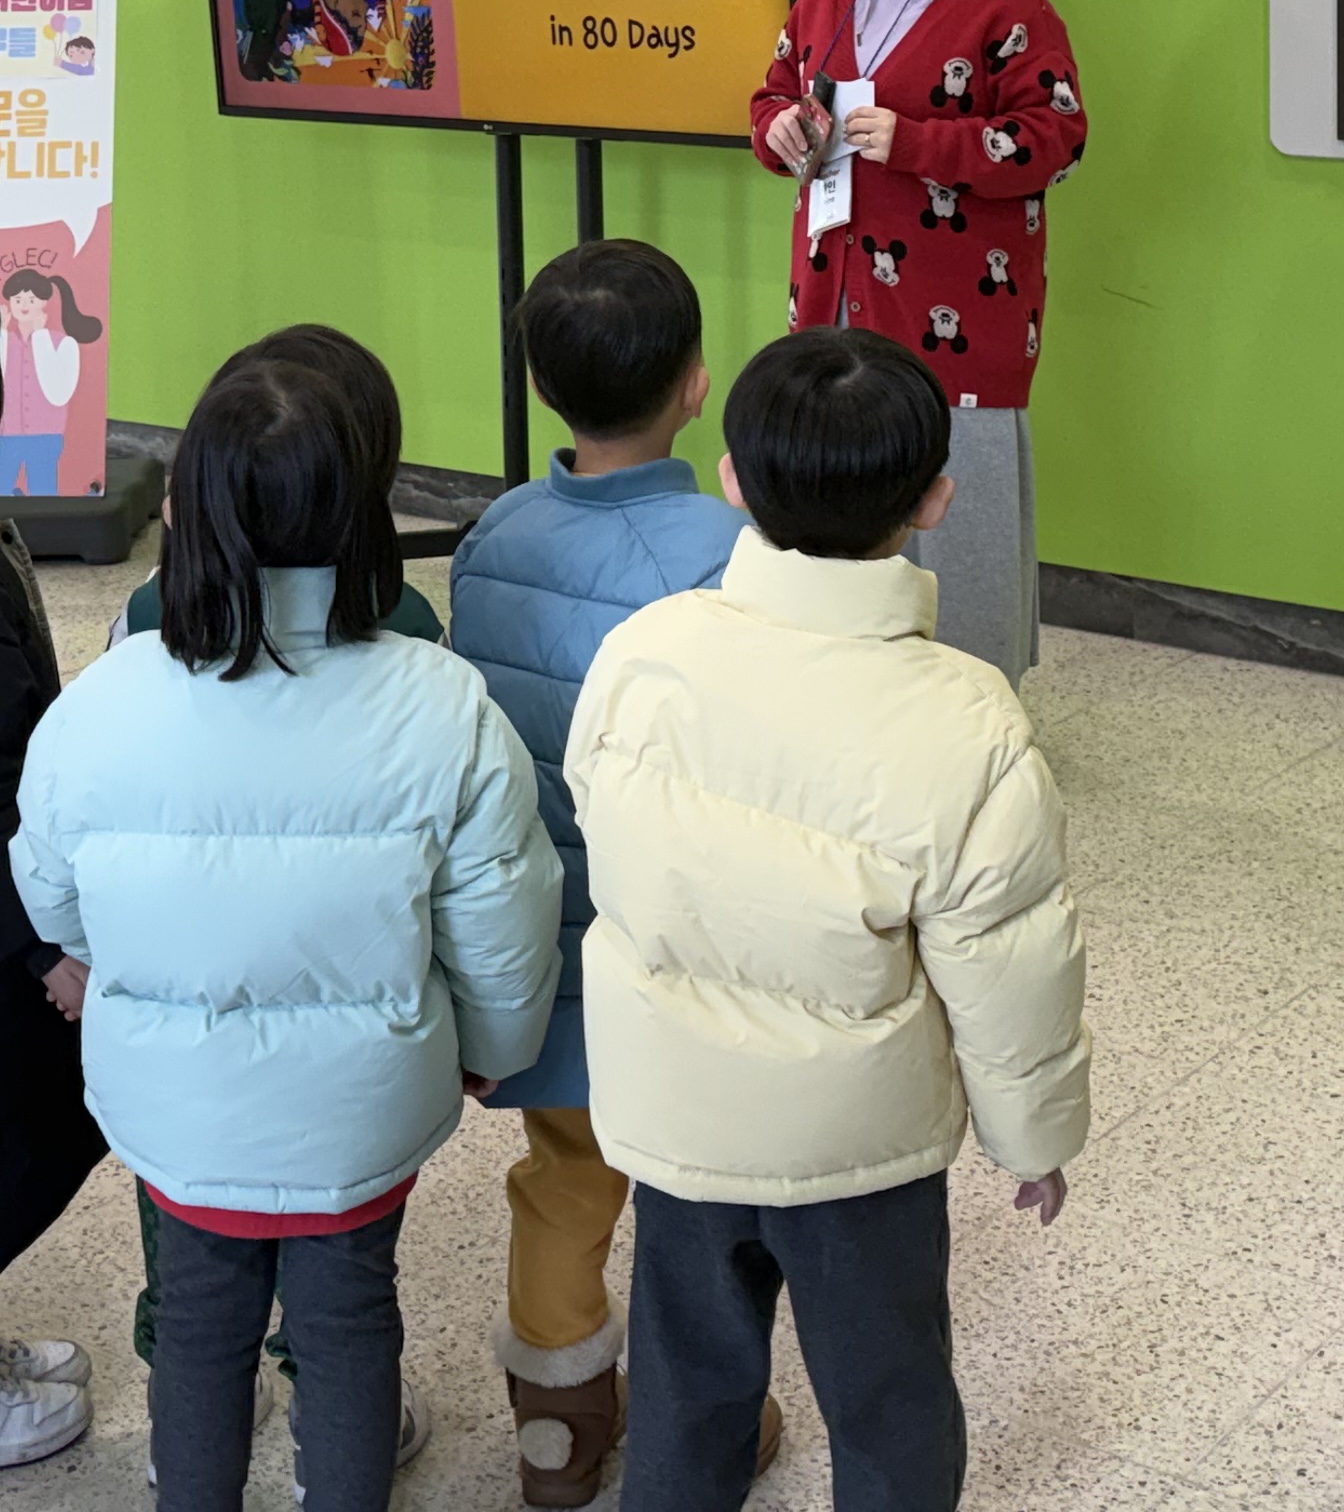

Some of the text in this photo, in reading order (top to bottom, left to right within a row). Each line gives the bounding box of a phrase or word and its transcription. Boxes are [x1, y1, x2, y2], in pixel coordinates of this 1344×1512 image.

[549, 15, 696, 59] in 80 Days
